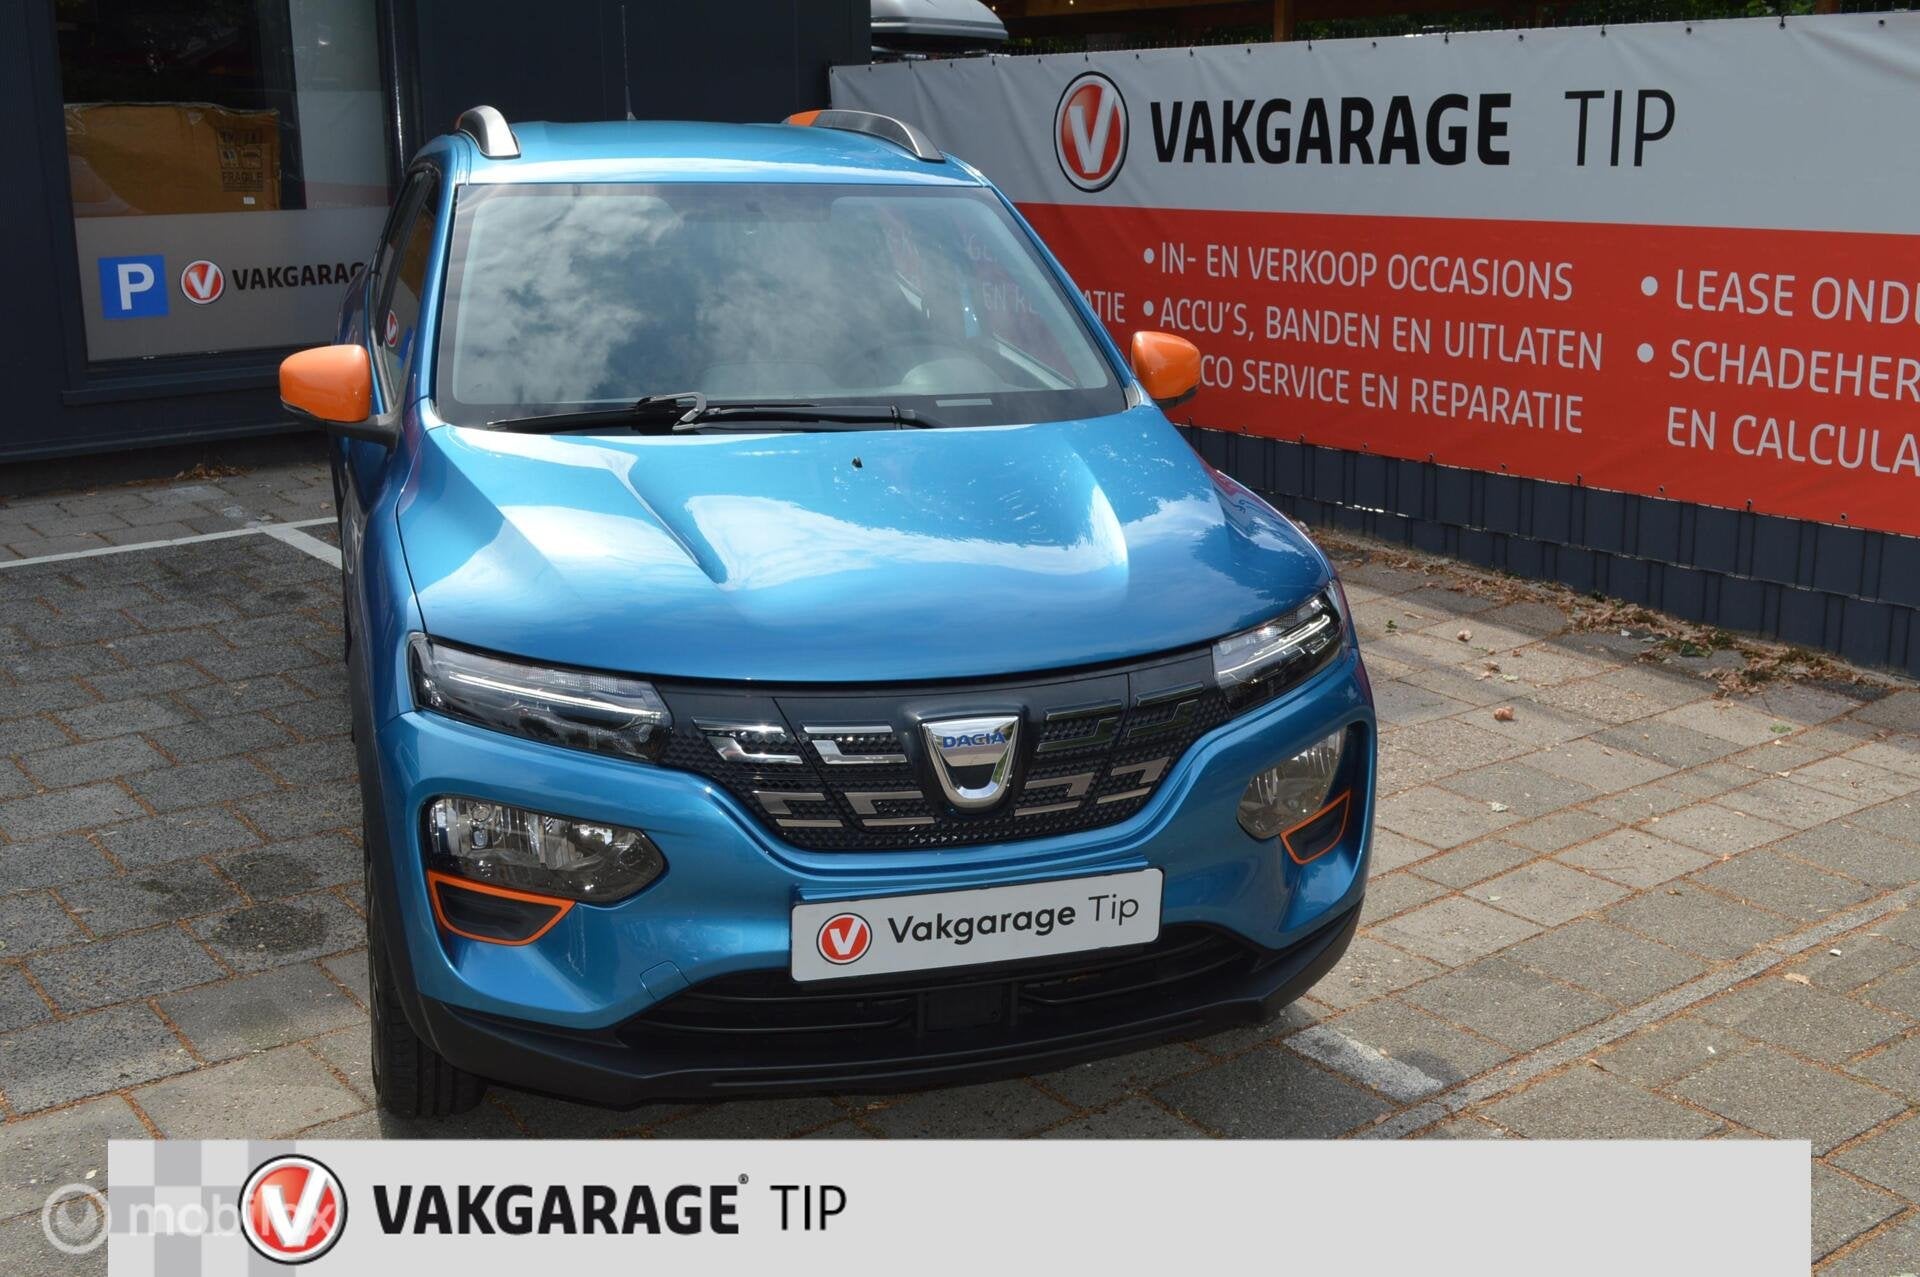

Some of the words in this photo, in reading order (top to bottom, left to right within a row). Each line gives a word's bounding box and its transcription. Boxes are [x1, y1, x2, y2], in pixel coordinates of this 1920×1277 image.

[1149, 92, 1512, 166] VAKGARAGE
[1564, 88, 1676, 167] TIP
[117, 263, 155, 311] P
[1161, 242, 1196, 275] IN-
[1206, 244, 1238, 279] EN
[1248, 247, 1377, 288] VERKOOP
[1387, 254, 1574, 301] OCCASIONS
[1675, 269, 1796, 317] LEASE
[1811, 276, 1920, 326] OND
[1266, 306, 1380, 349] BANDEN
[1392, 316, 1431, 355] EN
[1444, 319, 1603, 371] UITLATEN
[1242, 358, 1350, 405] SERVICE
[1361, 371, 1398, 411] EN
[1410, 379, 1584, 434] REPARATIE
[1667, 406, 1717, 450] EN
[942, 731, 1006, 748] DACIA
[887, 905, 1076, 946] Vakgarage
[1088, 894, 1140, 926] Tip
